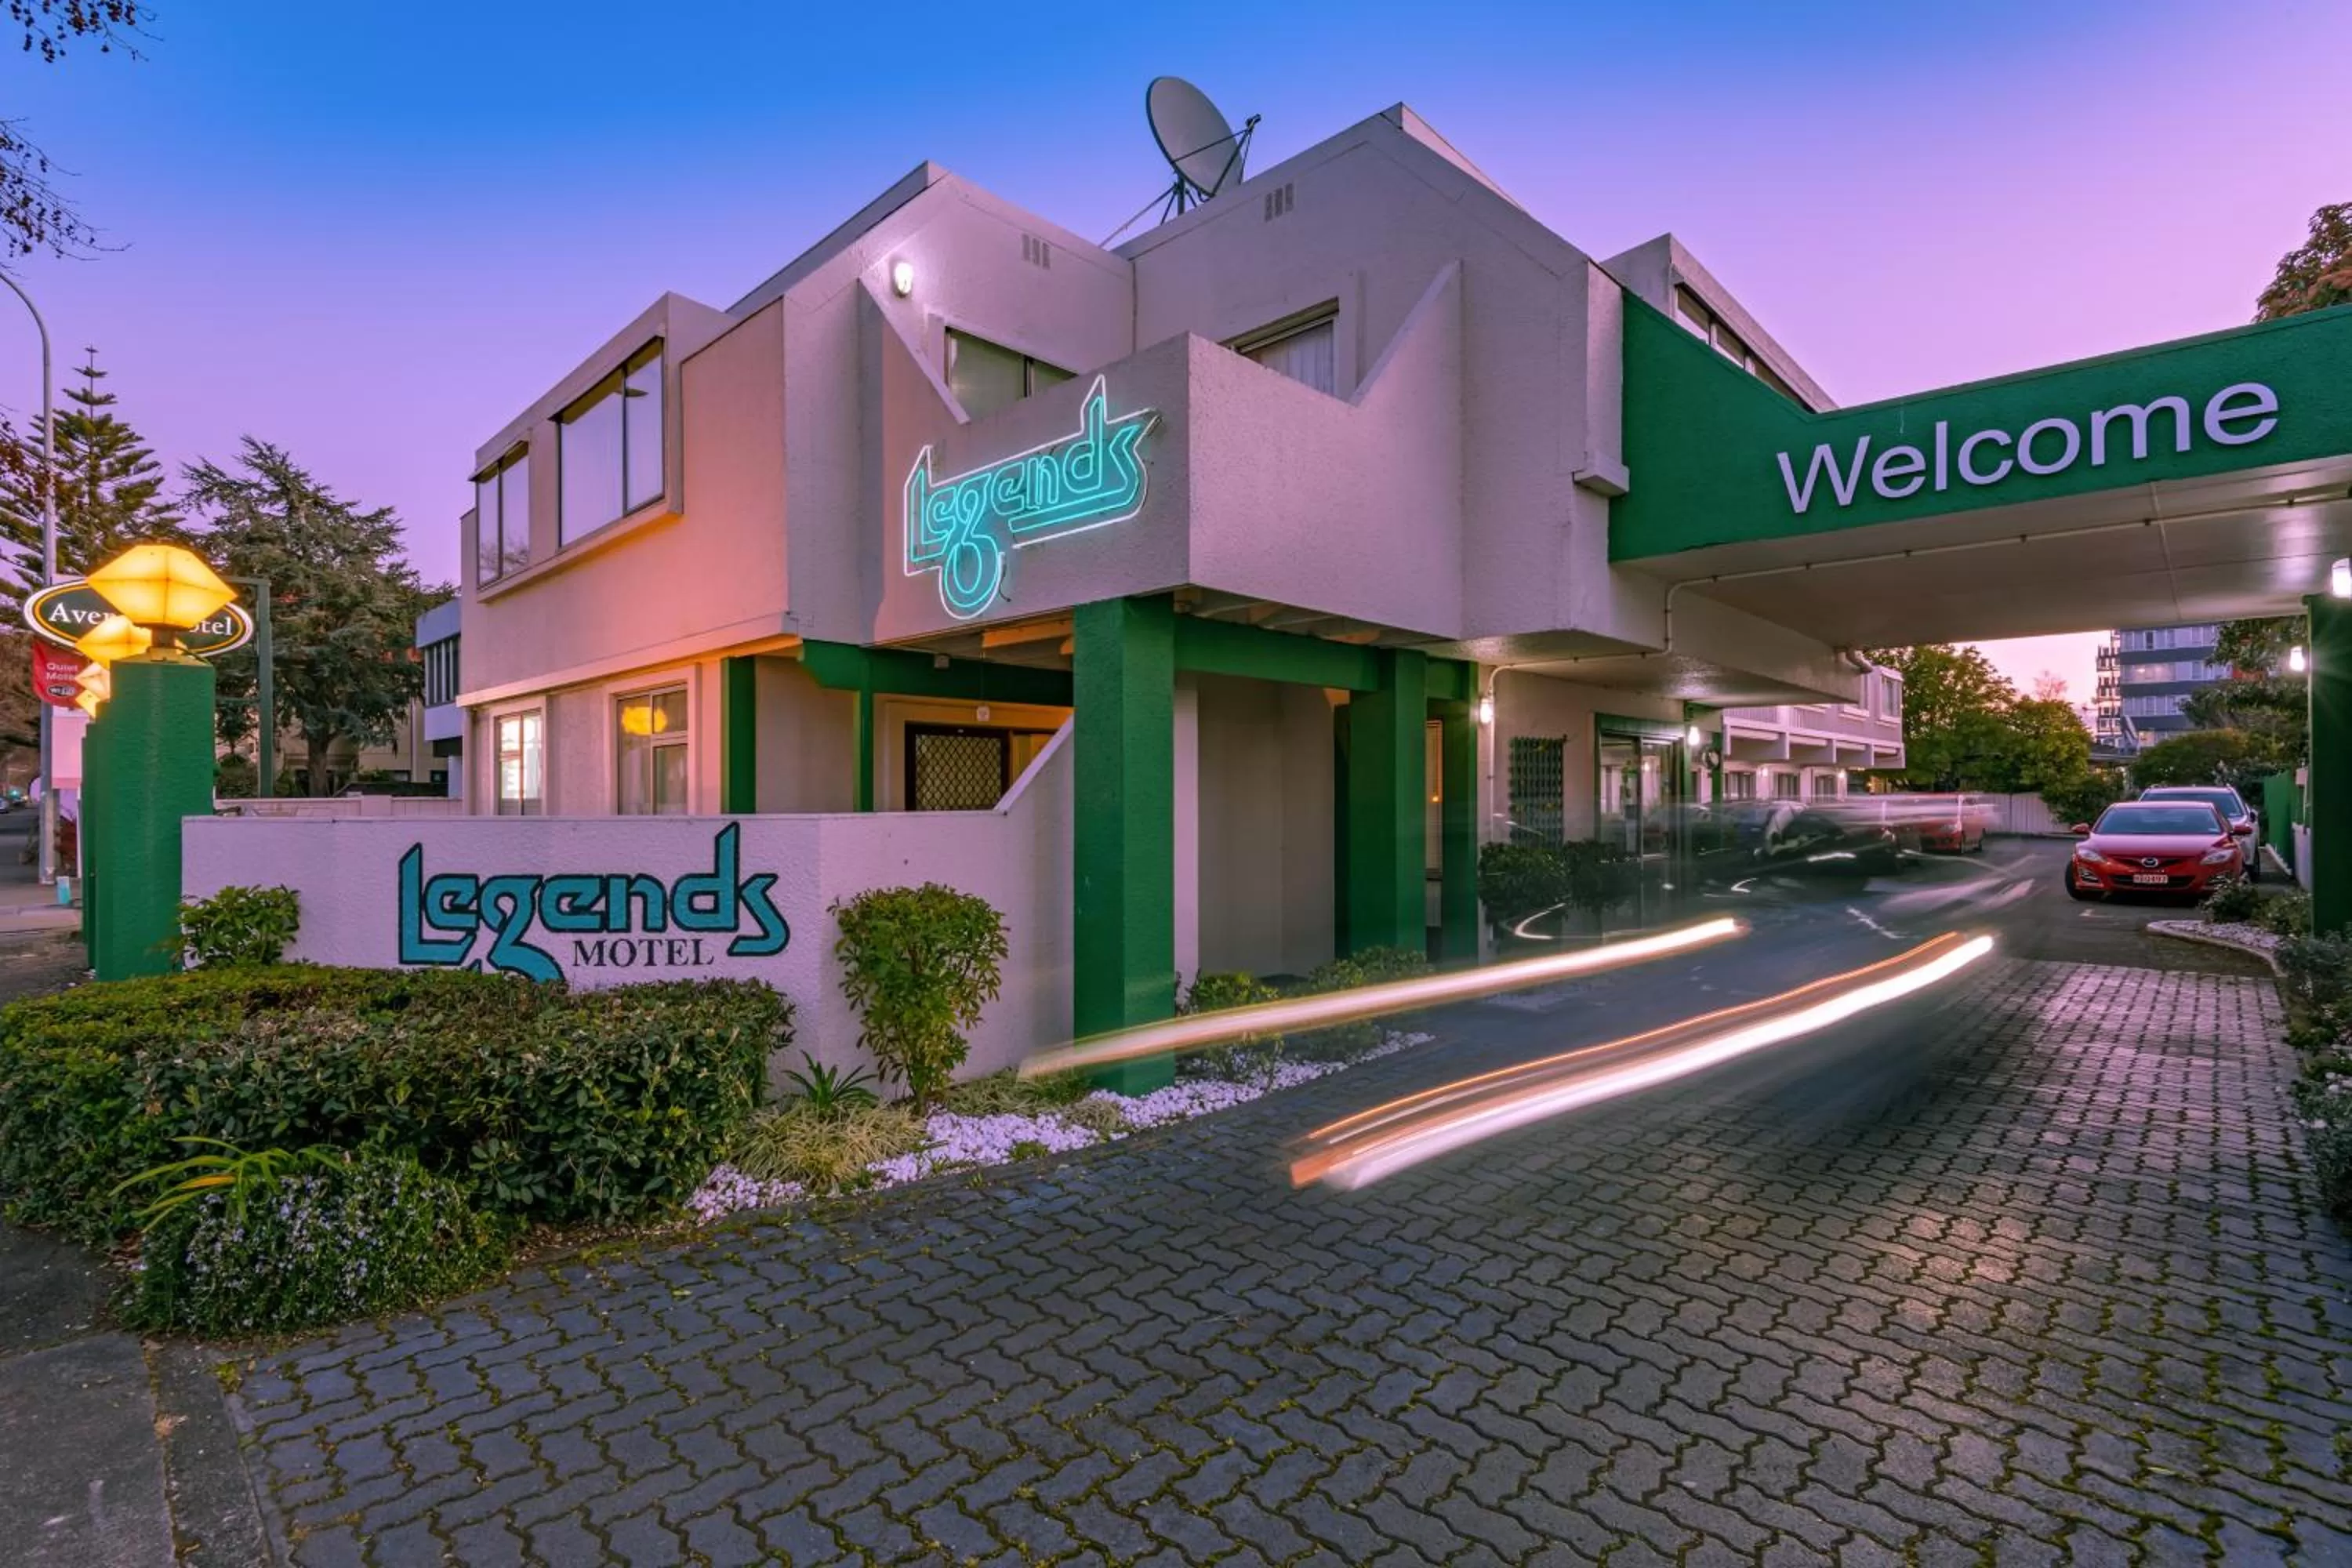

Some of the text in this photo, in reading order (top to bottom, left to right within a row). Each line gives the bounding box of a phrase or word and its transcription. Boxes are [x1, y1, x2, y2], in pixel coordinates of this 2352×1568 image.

[909, 393, 1142, 609] Legends
[1777, 382, 2280, 514] Welcome
[48, 601, 233, 636] Ave tel
[397, 821, 790, 982] Legends
[572, 938, 714, 967] MOTEL
